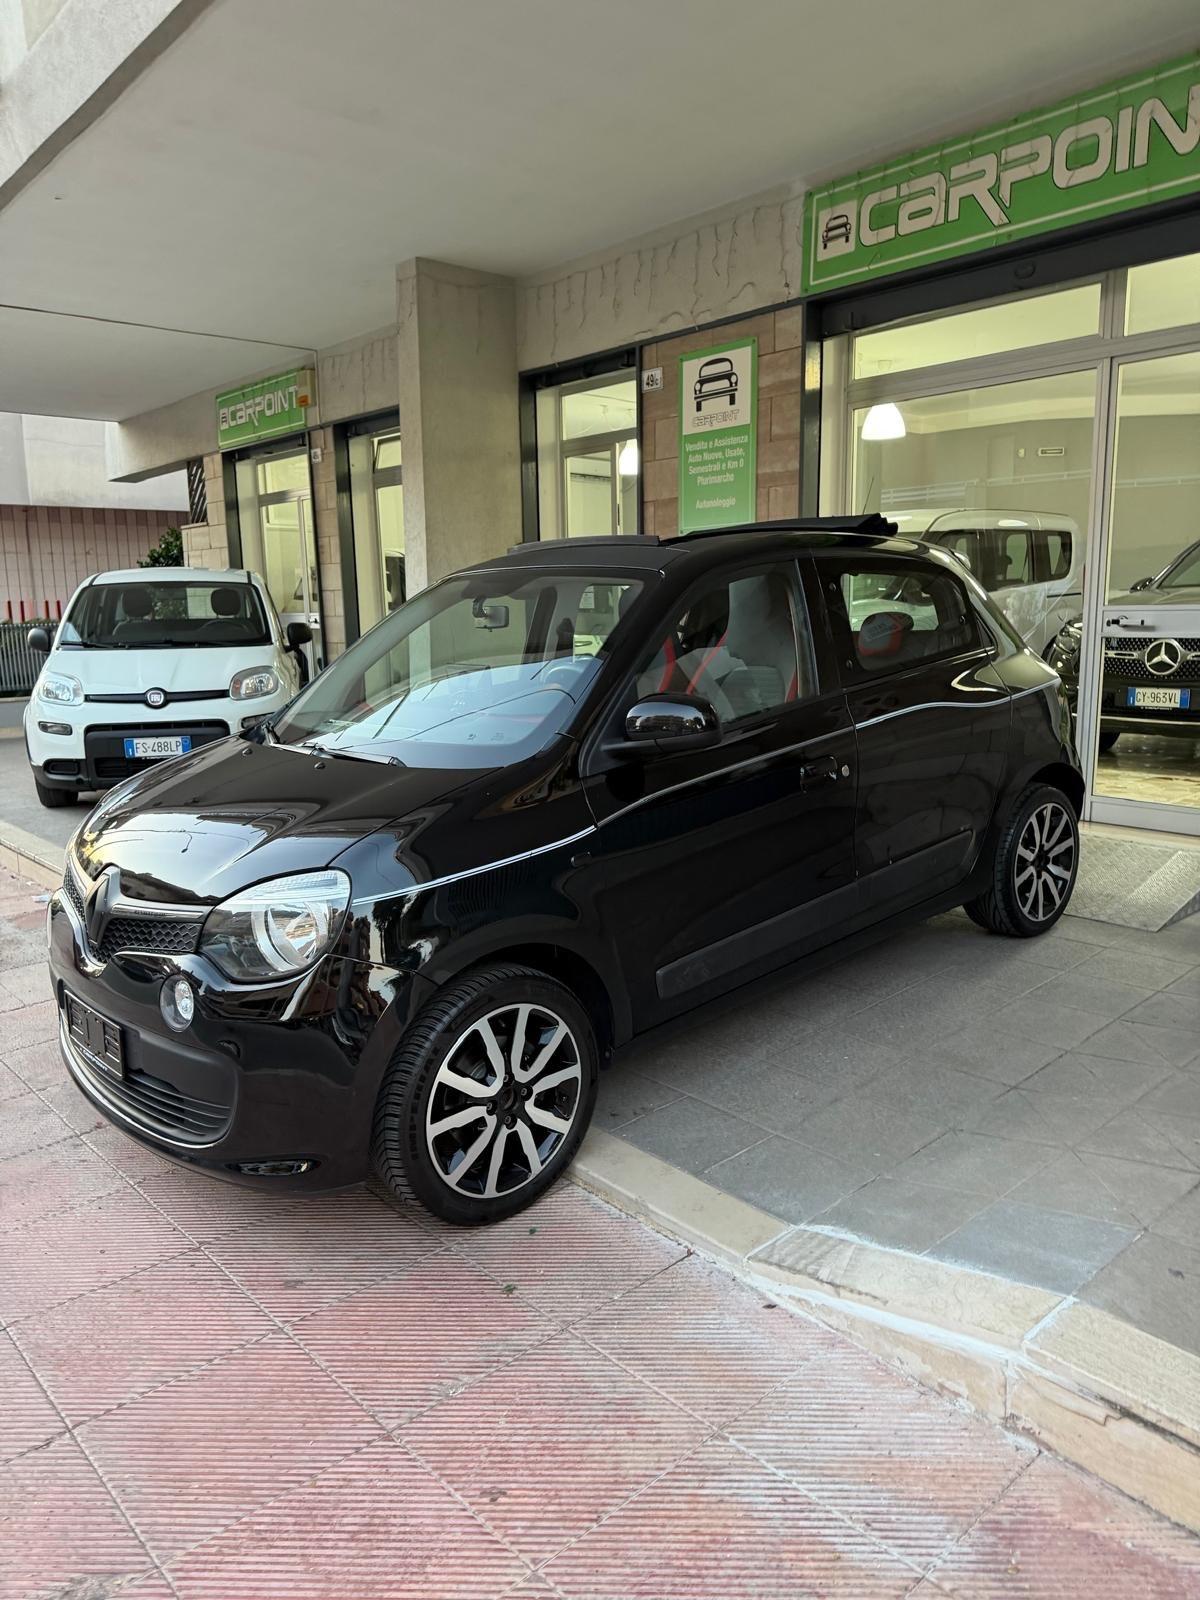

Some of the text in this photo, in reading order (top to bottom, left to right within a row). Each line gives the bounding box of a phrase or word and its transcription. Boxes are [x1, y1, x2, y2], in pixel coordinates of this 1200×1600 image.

[685, 440, 708, 452] Vendita
[714, 435, 748, 448] Assistenza
[688, 454, 702, 463] Auto
